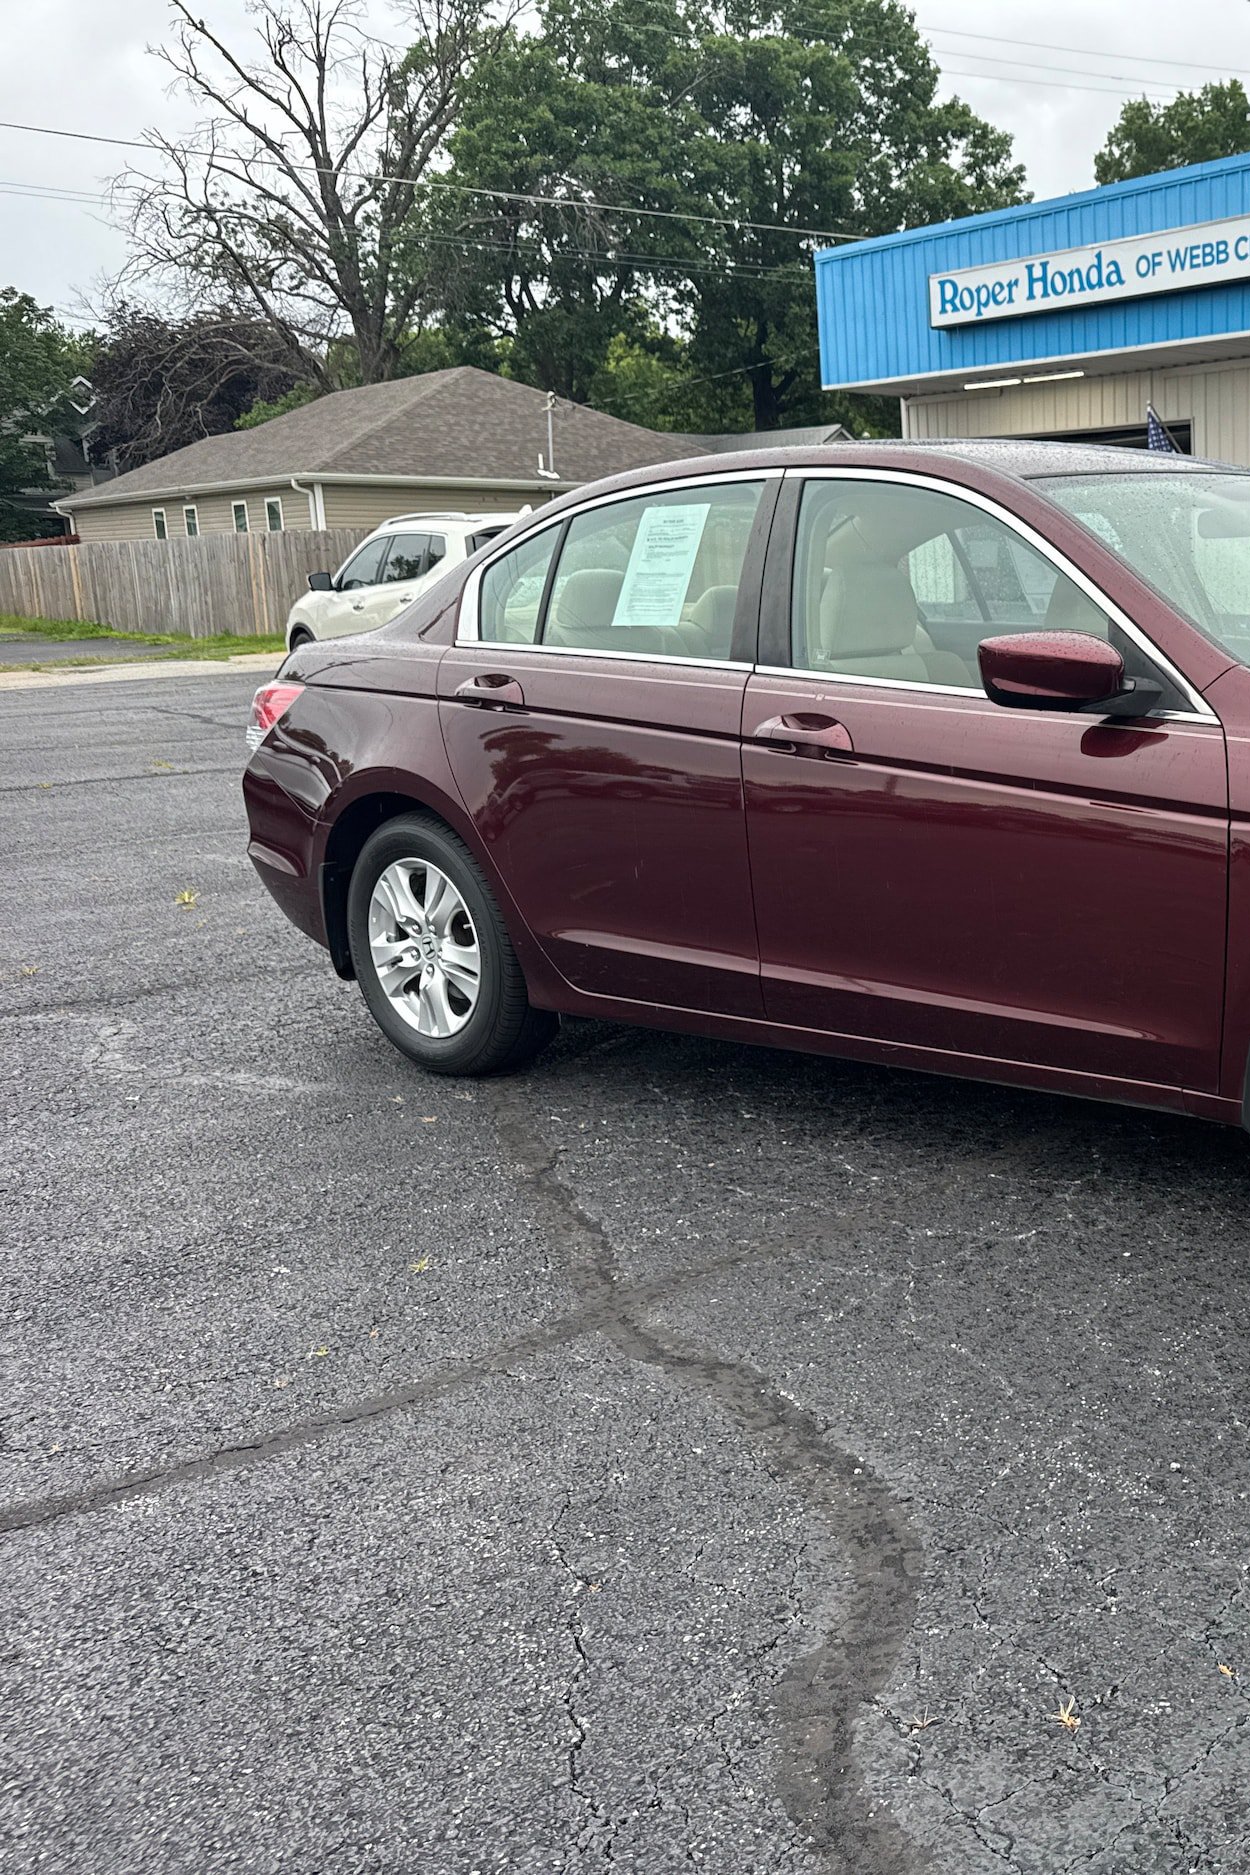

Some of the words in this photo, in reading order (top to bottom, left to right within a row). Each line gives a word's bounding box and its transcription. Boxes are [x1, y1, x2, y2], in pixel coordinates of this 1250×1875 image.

[937, 277, 1020, 317] Roper
[1025, 250, 1126, 302] Honda
[1135, 253, 1163, 279] OF
[1167, 242, 1230, 273] WEBB
